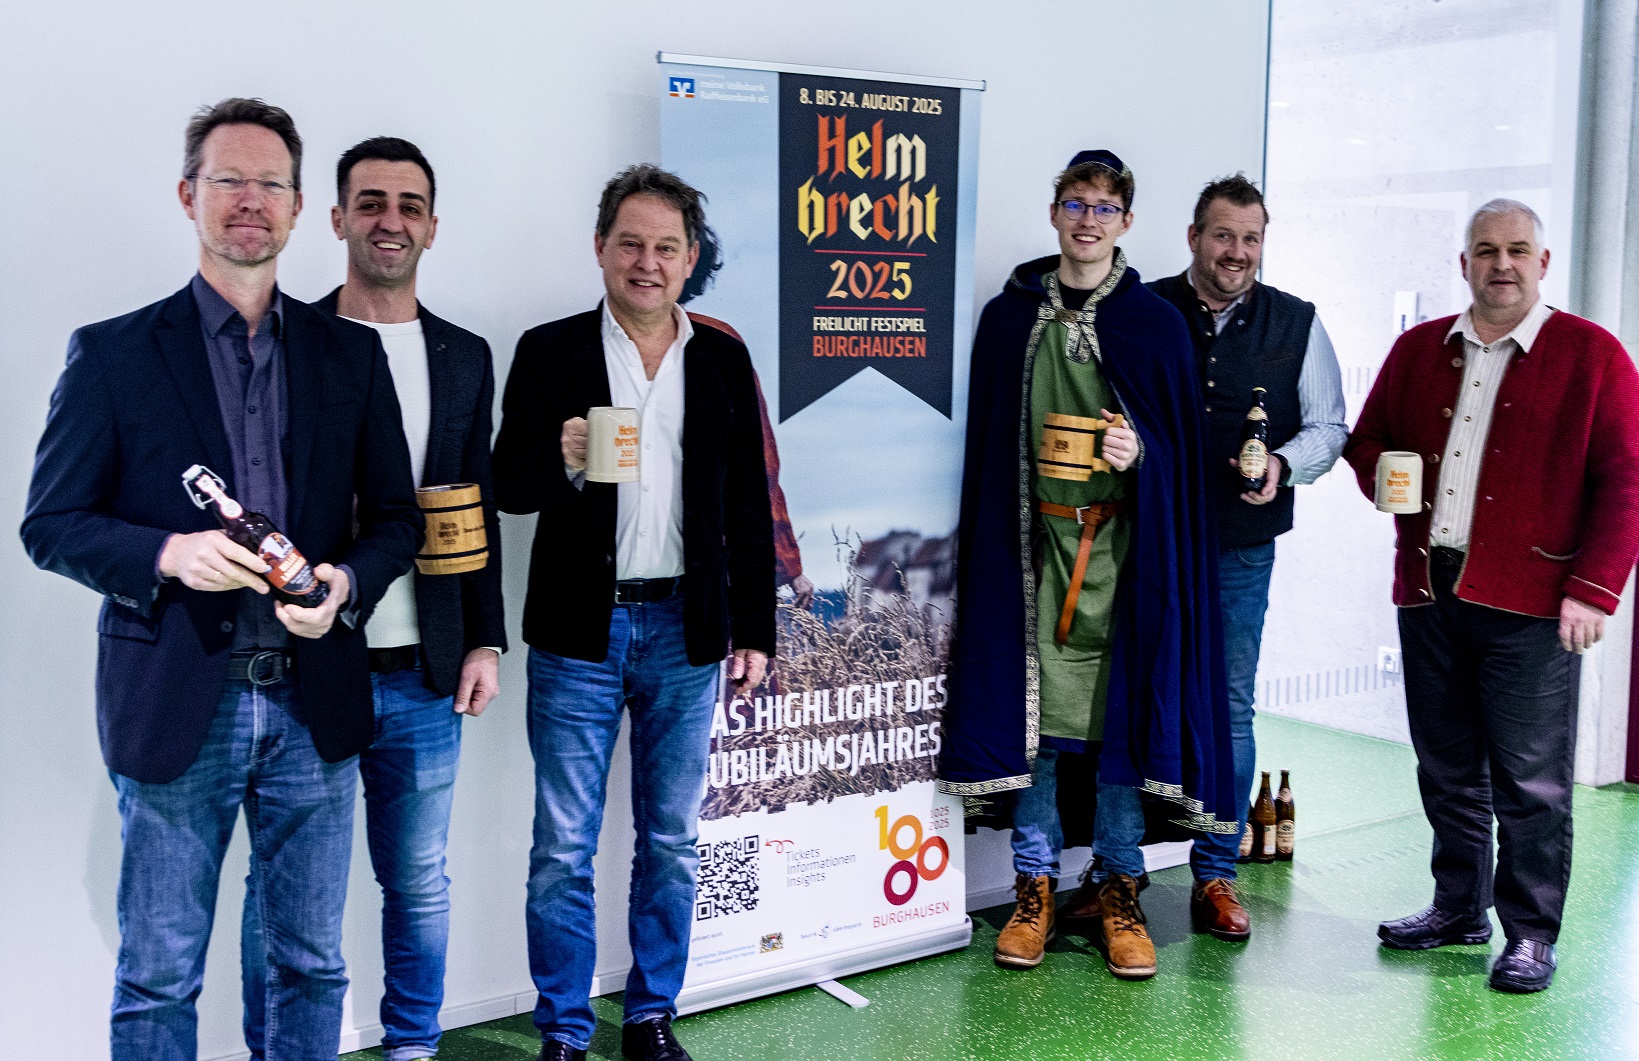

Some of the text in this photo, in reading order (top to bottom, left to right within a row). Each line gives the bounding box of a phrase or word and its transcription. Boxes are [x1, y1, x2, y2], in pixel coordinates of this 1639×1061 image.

[799, 88, 942, 115] 8. BIS 24. AUGUST 2025
[816, 113, 927, 183] Helm
[798, 175, 941, 250] brecht
[826, 259, 913, 301] 2025
[813, 316, 927, 333] FREILICHT FESTSPIEL
[812, 335, 927, 357] BURGHAUSEN
[709, 674, 949, 739] AS HIGHLIGHT DES
[786, 848, 820, 862] Tickets
[786, 854, 857, 875] Informationen
[786, 872, 826, 887] Insights
[873, 901, 950, 928] BURGHAUSEN
